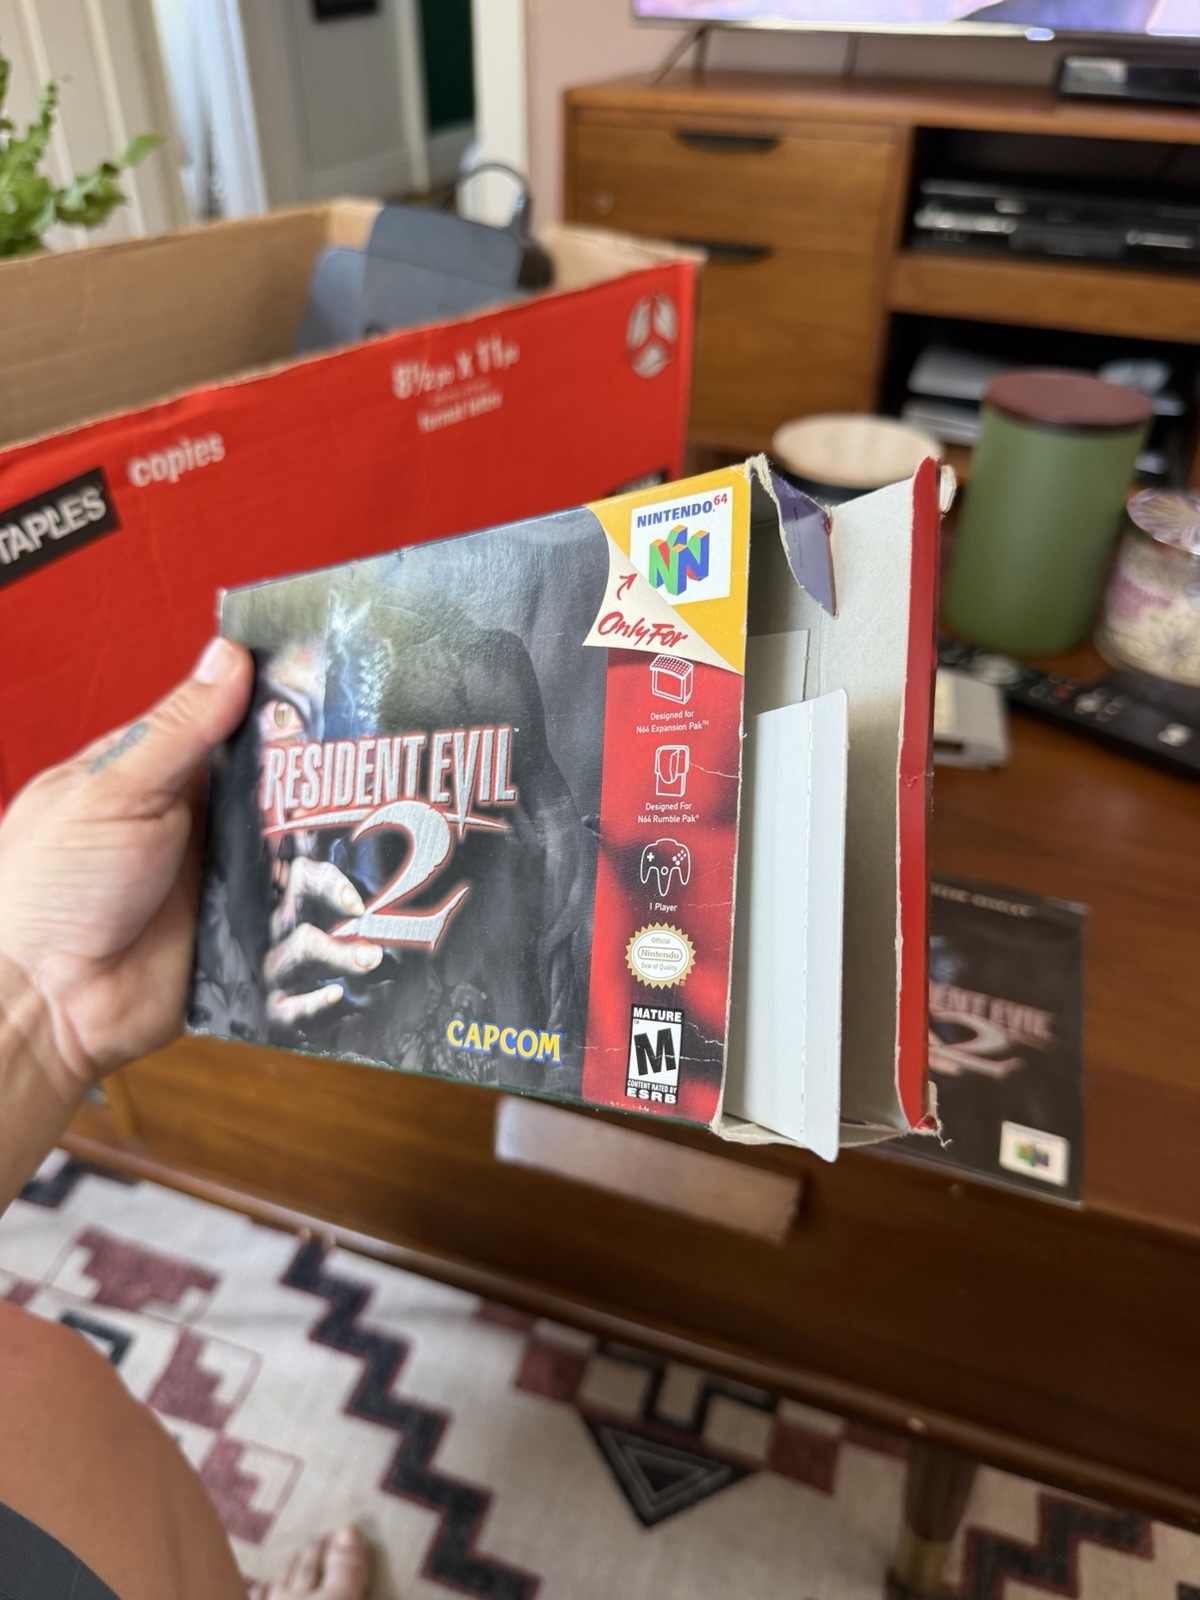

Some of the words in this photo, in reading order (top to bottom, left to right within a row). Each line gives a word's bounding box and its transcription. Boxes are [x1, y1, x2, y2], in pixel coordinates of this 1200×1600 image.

[128, 434, 224, 487] copies
[637, 500, 713, 528] NINTENDO
[0, 486, 106, 564] TAPLES
[597, 611, 650, 646] Only
[646, 623, 689, 648] For
[650, 711, 683, 721] Designed
[684, 710, 695, 718] for
[636, 725, 650, 734] N64
[651, 722, 687, 734] Expansion
[262, 734, 426, 828] RESIDENT
[430, 727, 516, 837] EVIL
[645, 802, 679, 812] Designed
[680, 801, 692, 810] For
[637, 815, 652, 823] N64
[653, 814, 681, 823] Rumble
[331, 799, 470, 950] 2
[655, 902, 678, 913] Player
[651, 936, 671, 944] Official
[641, 948, 680, 959] Nintendo
[660, 964, 678, 972] Quality
[633, 1006, 682, 1022] MATURE
[445, 1018, 562, 1063] CAPCOM
[634, 1027, 676, 1077] M
[627, 1079, 651, 1090] CONTENT
[651, 1083, 669, 1093] RATED
[669, 1086, 678, 1094] BY
[626, 1086, 677, 1104] ESRB
